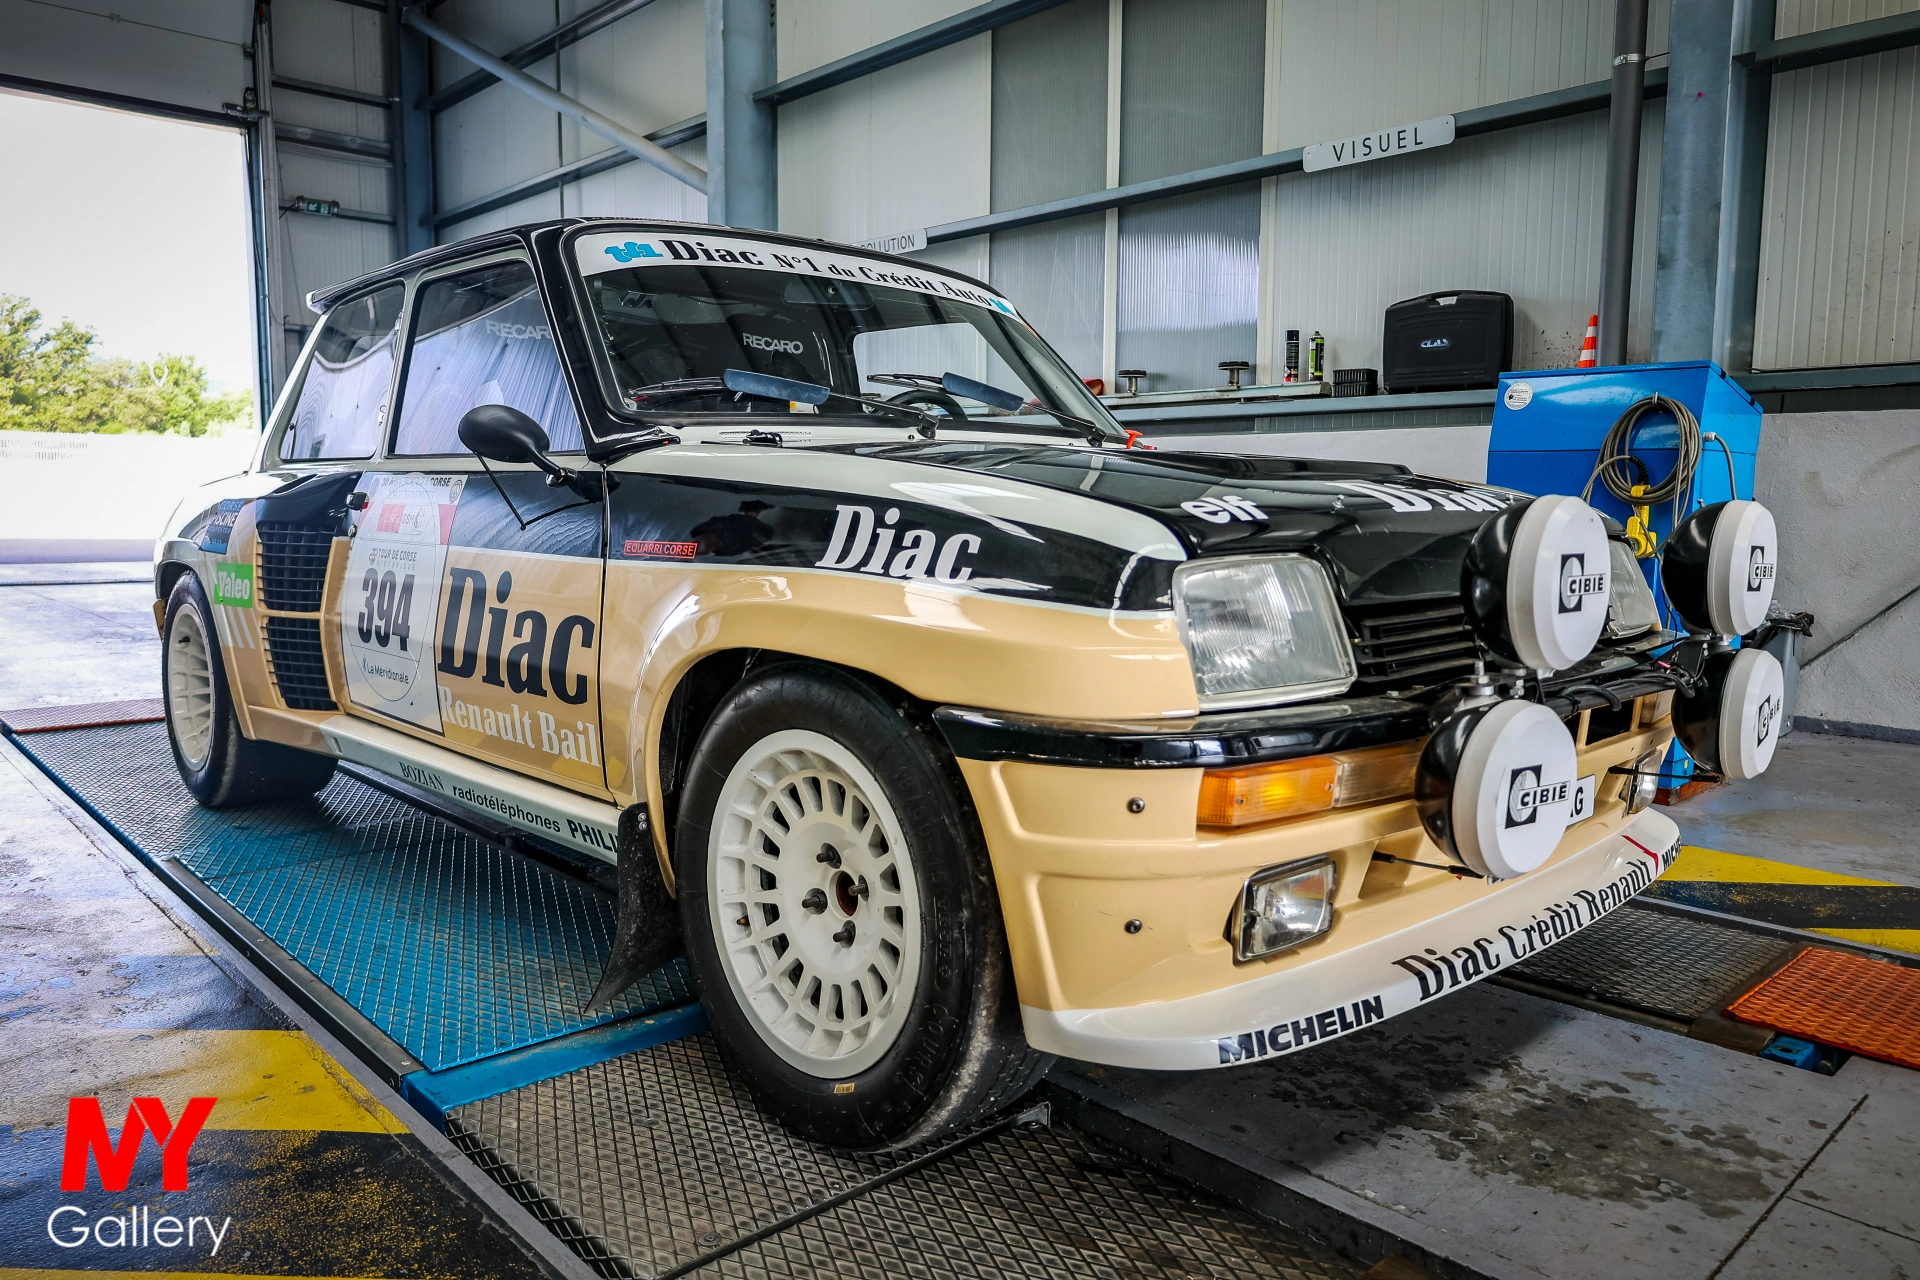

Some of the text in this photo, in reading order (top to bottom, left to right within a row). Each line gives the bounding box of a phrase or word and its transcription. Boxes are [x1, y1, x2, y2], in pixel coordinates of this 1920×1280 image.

[1332, 127, 1424, 162] VISUEL
[860, 234, 915, 253] OLLUTION
[658, 239, 992, 307] Diac N°1 du Crédit Auto
[742, 332, 804, 355] RECARO
[1179, 495, 1269, 524] elf
[378, 548, 417, 562] TOUR DE CORSE
[626, 543, 696, 557] EQUARRI CORSE
[814, 504, 983, 585] Diac
[217, 571, 251, 600] Valeo
[357, 568, 416, 652] 394
[437, 567, 596, 705] Diac
[366, 662, 410, 685] La Méridionale
[438, 684, 602, 768] Renault Bail
[398, 761, 619, 854] BOZIAN radiotéléphones PHILI
[1392, 937, 1501, 1002] Diac
[1573, 858, 1652, 921] Renault
[1218, 995, 1385, 1065] MICHELIN
